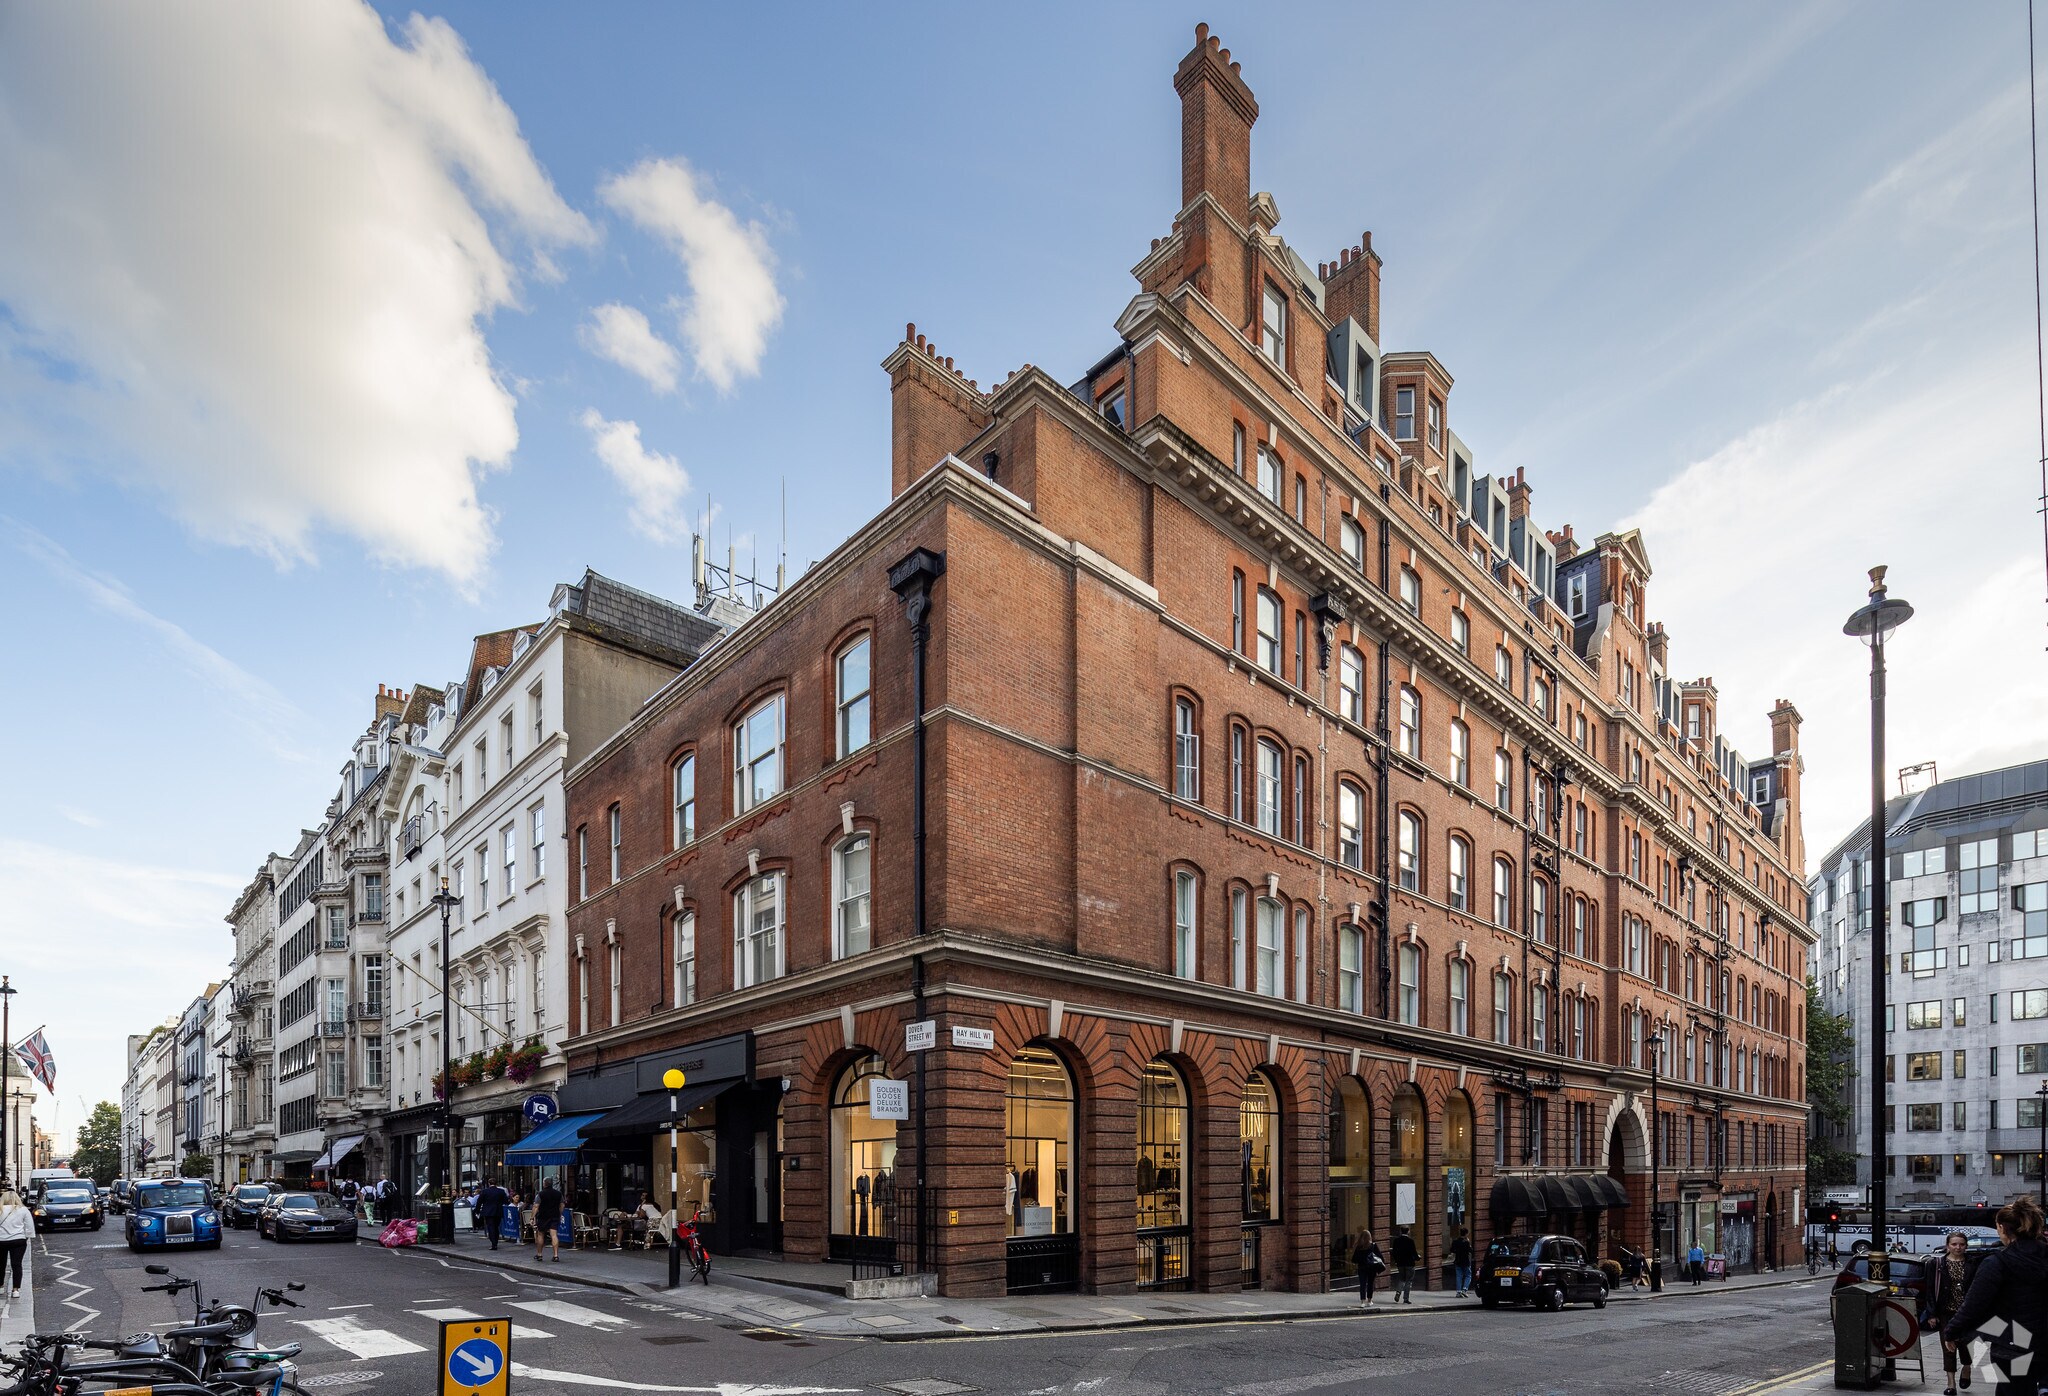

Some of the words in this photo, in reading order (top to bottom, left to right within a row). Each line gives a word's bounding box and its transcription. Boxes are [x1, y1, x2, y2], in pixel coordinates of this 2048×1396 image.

[908, 1024, 924, 1034] DOVER
[956, 1029, 968, 1037] HAY
[969, 1031, 981, 1039] HILL
[982, 1032, 991, 1040] W1
[908, 1032, 924, 1043] STREET
[925, 1032, 933, 1040] W1
